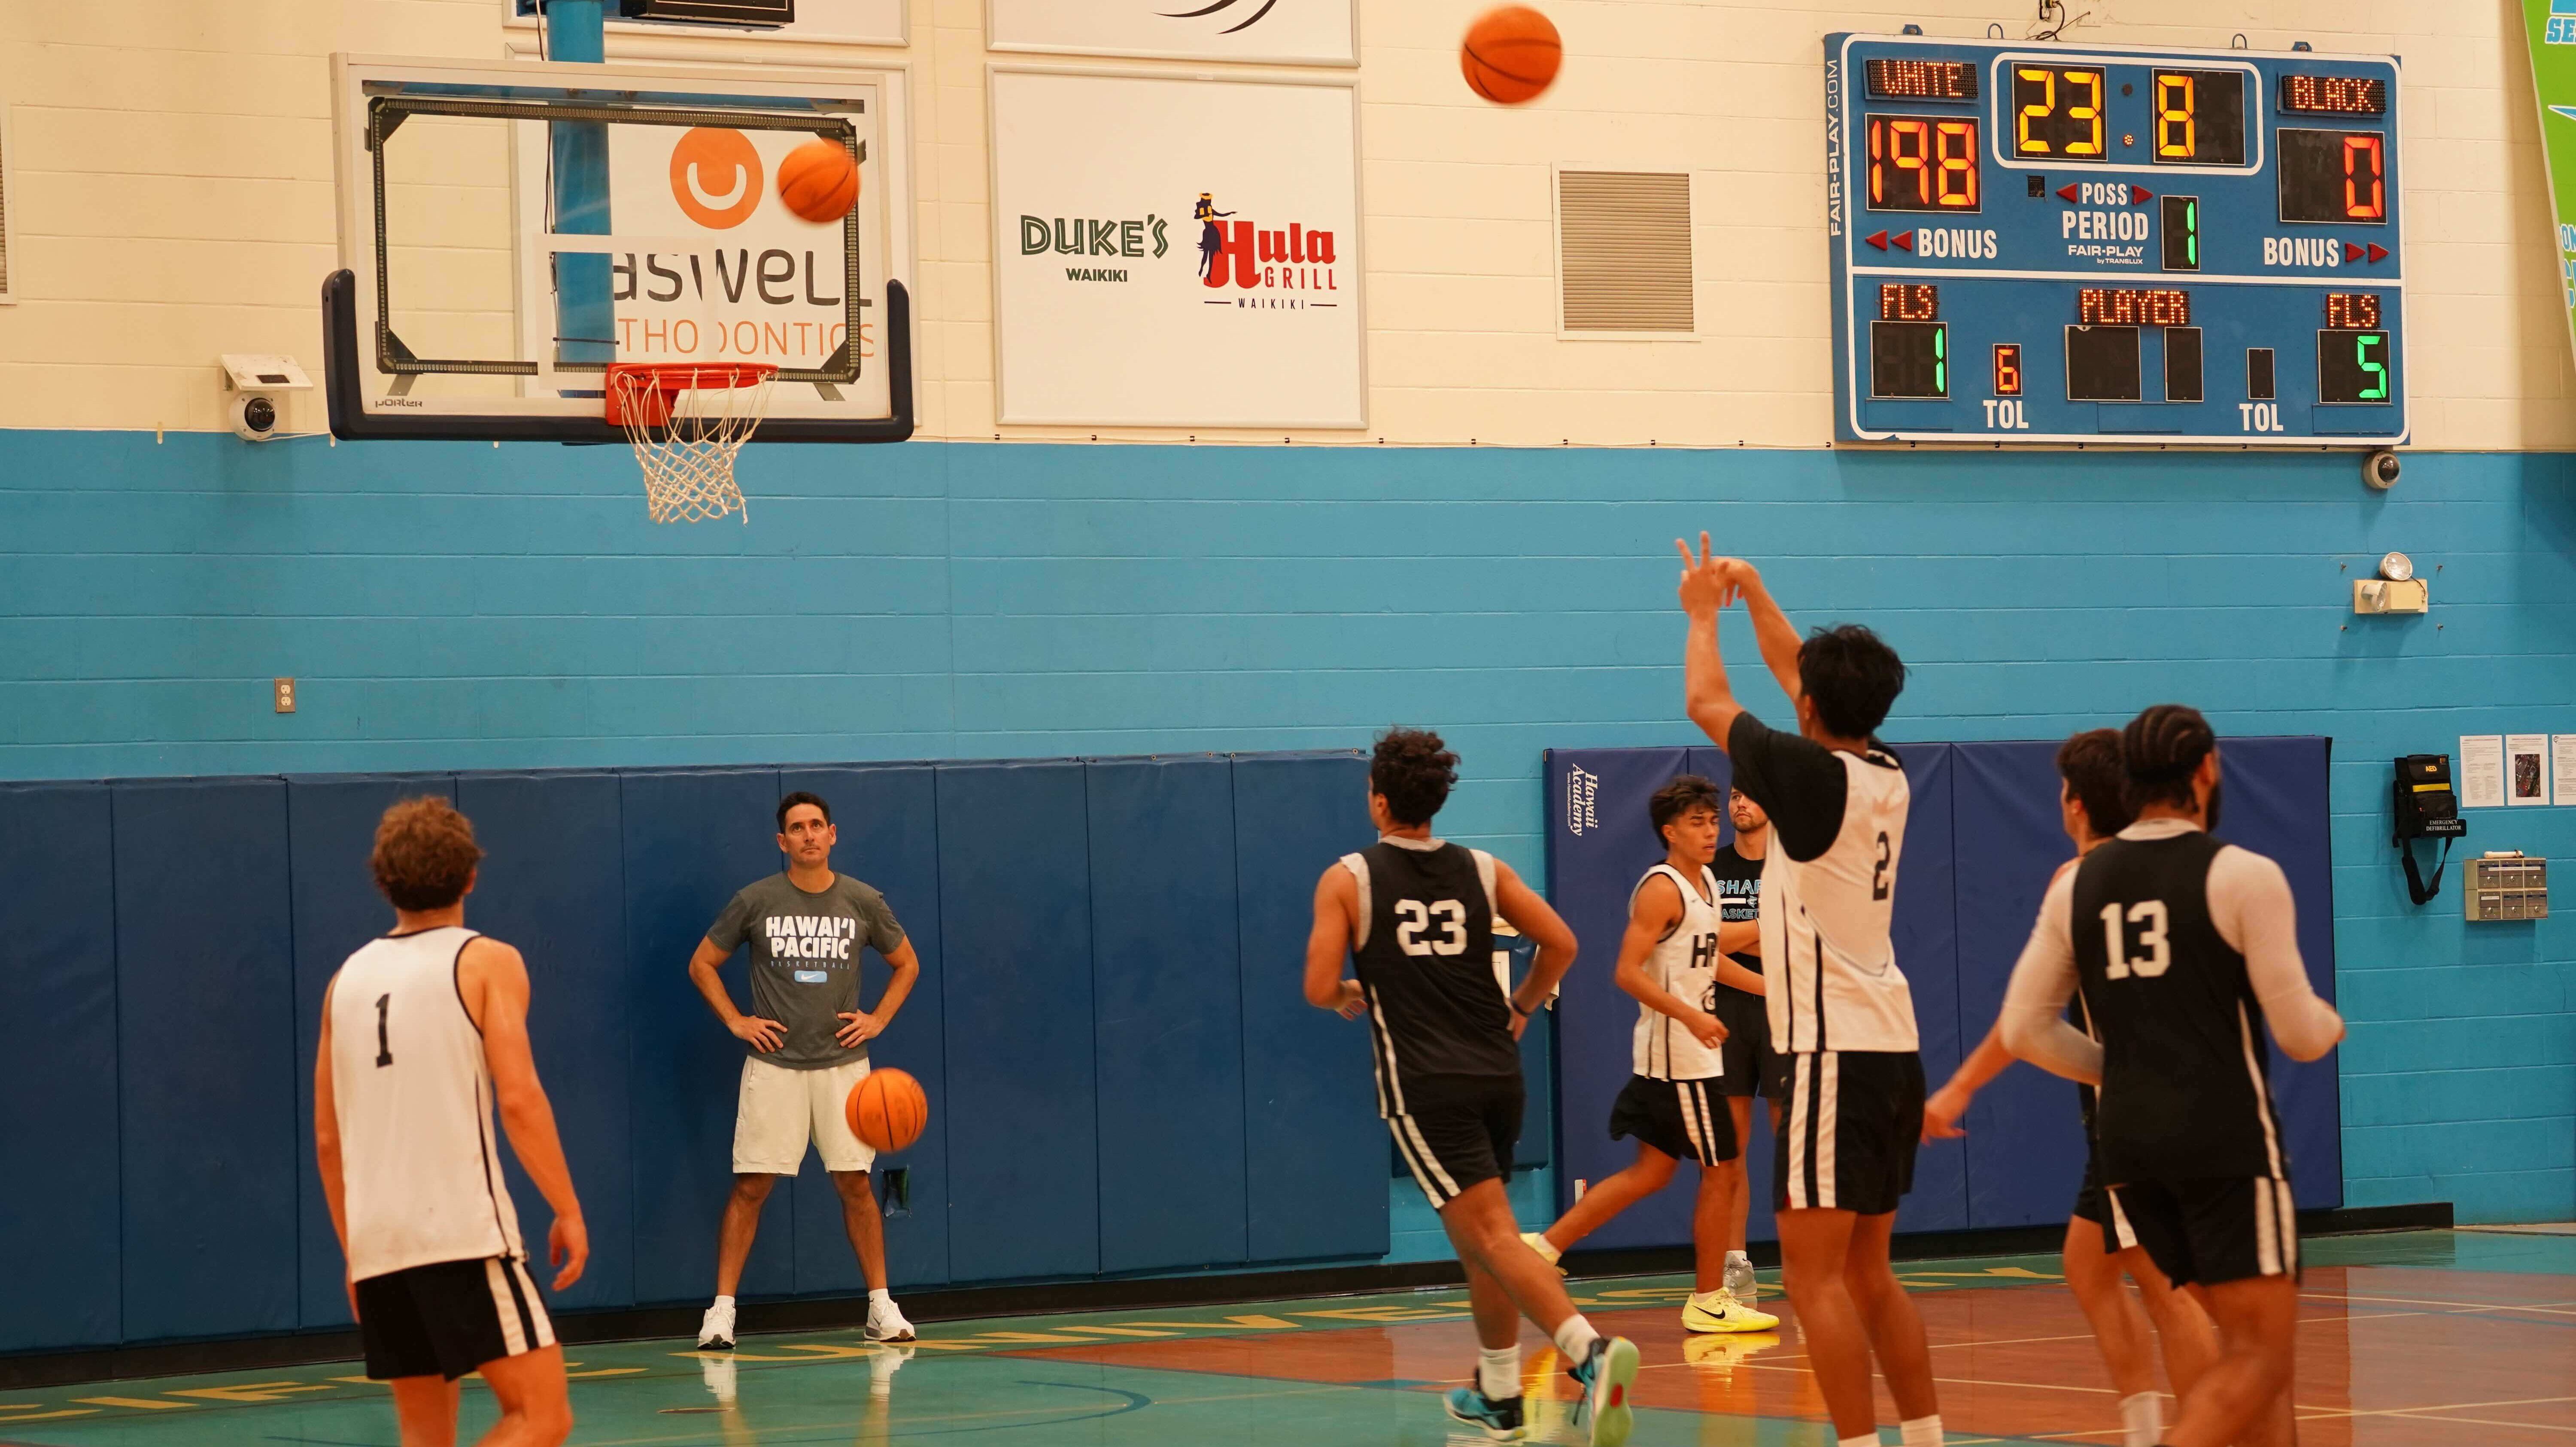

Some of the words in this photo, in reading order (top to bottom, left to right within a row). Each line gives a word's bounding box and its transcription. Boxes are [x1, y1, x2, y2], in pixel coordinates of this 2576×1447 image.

[2544, 15, 2576, 45] SE
[1883, 60, 1963, 97] WHITE
[2294, 76, 2376, 112] BLACK
[2018, 69, 2102, 154] 23
[2158, 74, 2195, 157] 8
[1827, 59, 1842, 236] FAIR-PLAY.COM
[1872, 120, 1976, 206] 198
[2082, 182, 2128, 206] POSS
[2343, 137, 2382, 218] 0
[1020, 213, 1169, 259] DUKE'S
[1918, 228, 1998, 259] BONUS
[2063, 211, 2148, 240] PERIOD
[2187, 201, 2196, 265] 1
[1203, 220, 1337, 289] Hula
[2068, 245, 2144, 257] FAIR-PLAY
[2263, 237, 2340, 268] BONUS
[1066, 268, 1128, 283] WAIKIKI
[1264, 267, 1337, 290] GRILL
[1238, 297, 1304, 310] WAIKIKI
[1883, 284, 1932, 319] FLS
[2081, 289, 2185, 324] PLAYER
[2329, 293, 2376, 327] FLS
[1935, 328, 1944, 393] 1
[1998, 348, 2018, 392] 6
[2357, 335, 2387, 399] 5
[1983, 399, 2029, 429] TOL
[2239, 403, 2284, 432] TOL
[1570, 763, 1585, 836] Academy
[1585, 772, 1598, 828] Hawaii
[1873, 830, 1891, 901] 2
[1394, 899, 1467, 956] 23
[2099, 899, 2172, 980] 13
[771, 936, 850, 960] PACIFIC
[771, 961, 850, 970] BASKETBALL
[375, 992, 393, 1068] 1
